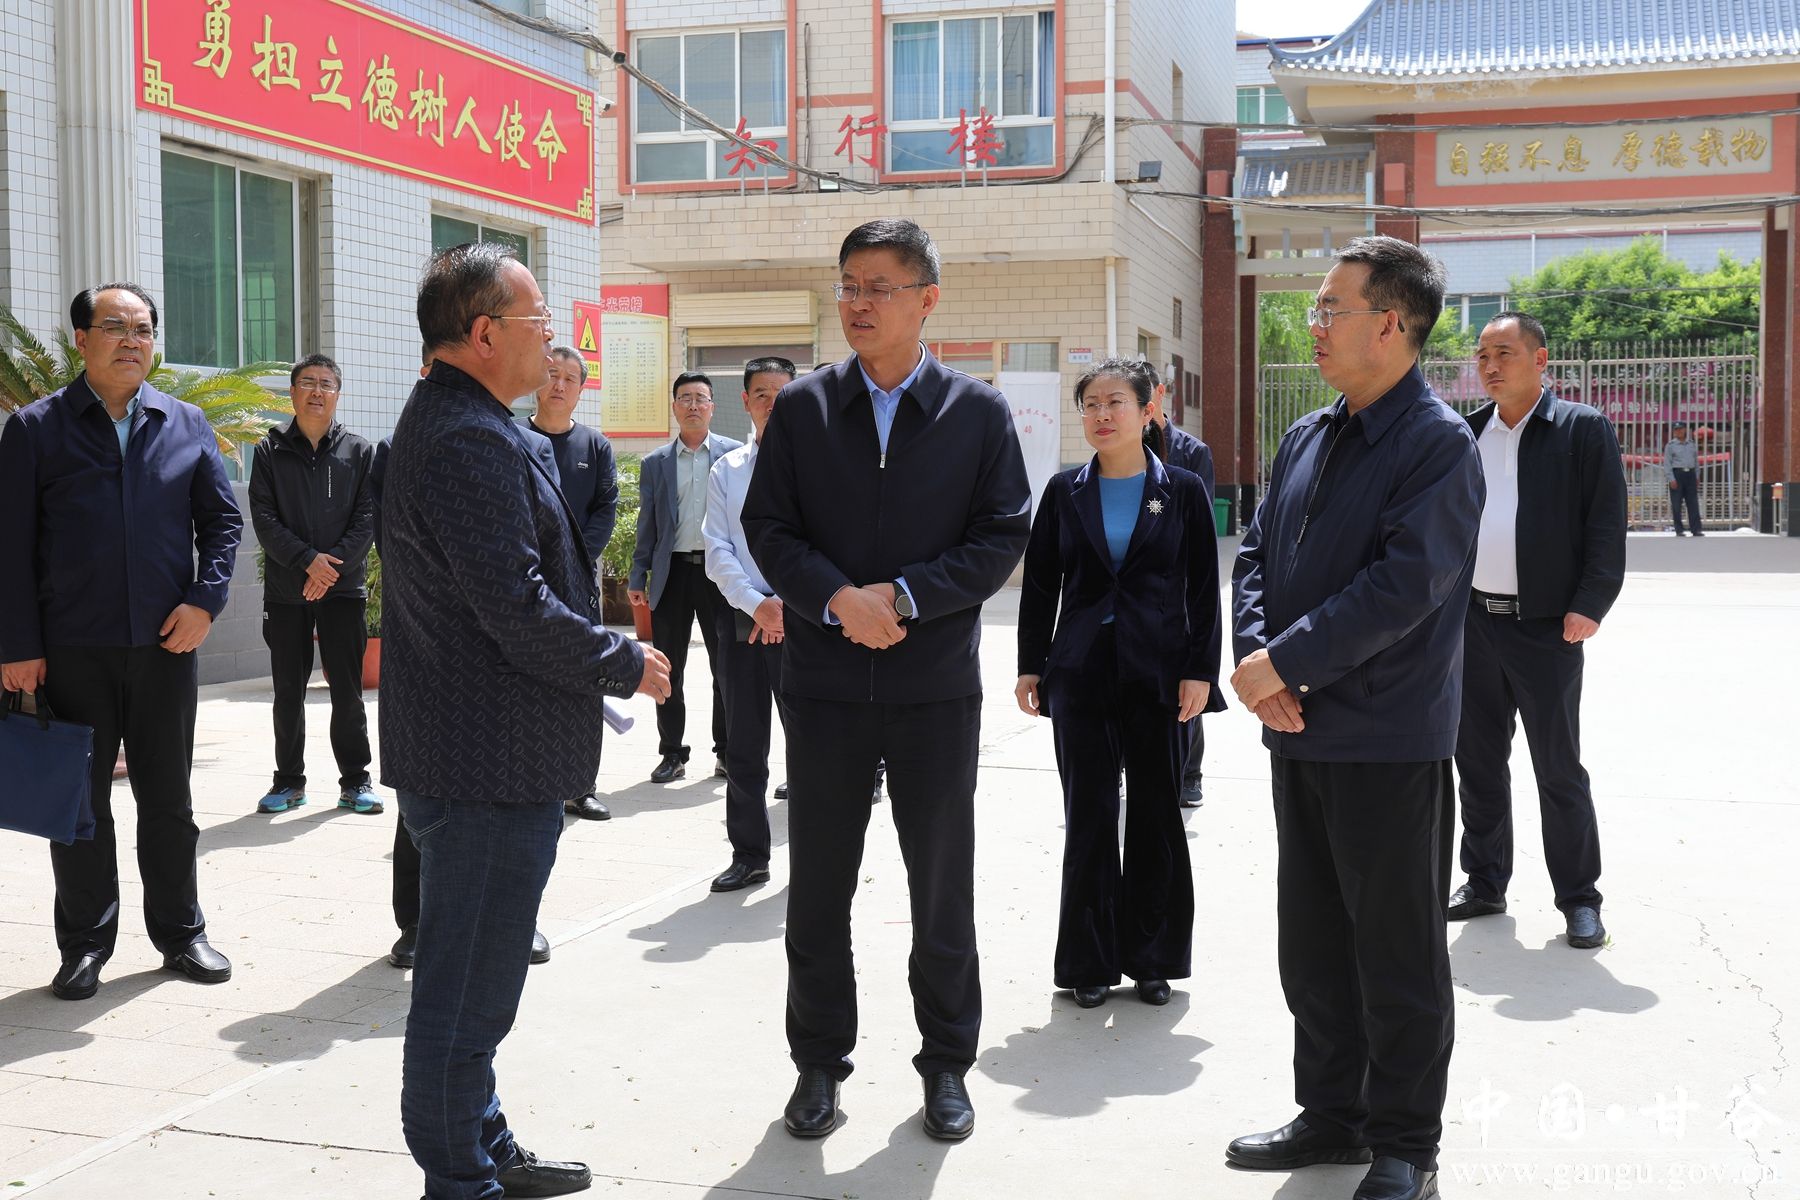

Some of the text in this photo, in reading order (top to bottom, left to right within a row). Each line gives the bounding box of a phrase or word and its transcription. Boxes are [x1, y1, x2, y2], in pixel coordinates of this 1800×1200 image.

[193, 0, 568, 181] 勇担立德树人使命
[723, 106, 1005, 177] 知行楼
[1450, 126, 1768, 176] 自强不息 厚德载物
